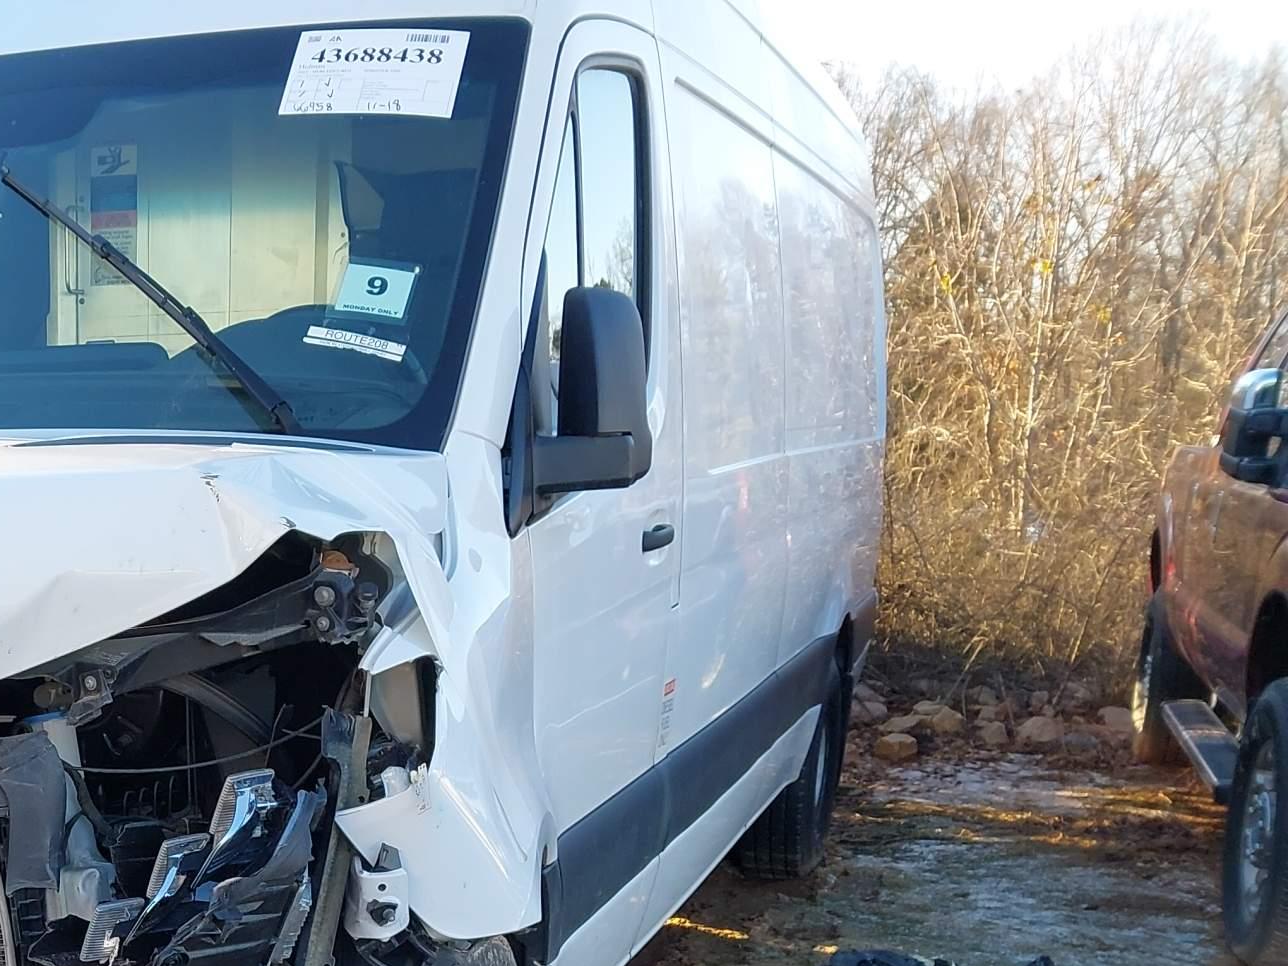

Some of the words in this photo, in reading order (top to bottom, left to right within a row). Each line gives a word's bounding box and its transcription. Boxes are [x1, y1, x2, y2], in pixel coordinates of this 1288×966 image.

[311, 47, 444, 64] 43688438
[365, 276, 389, 296] 9
[343, 304, 376, 313] MONDAY
[324, 329, 390, 350] ROUTE208
